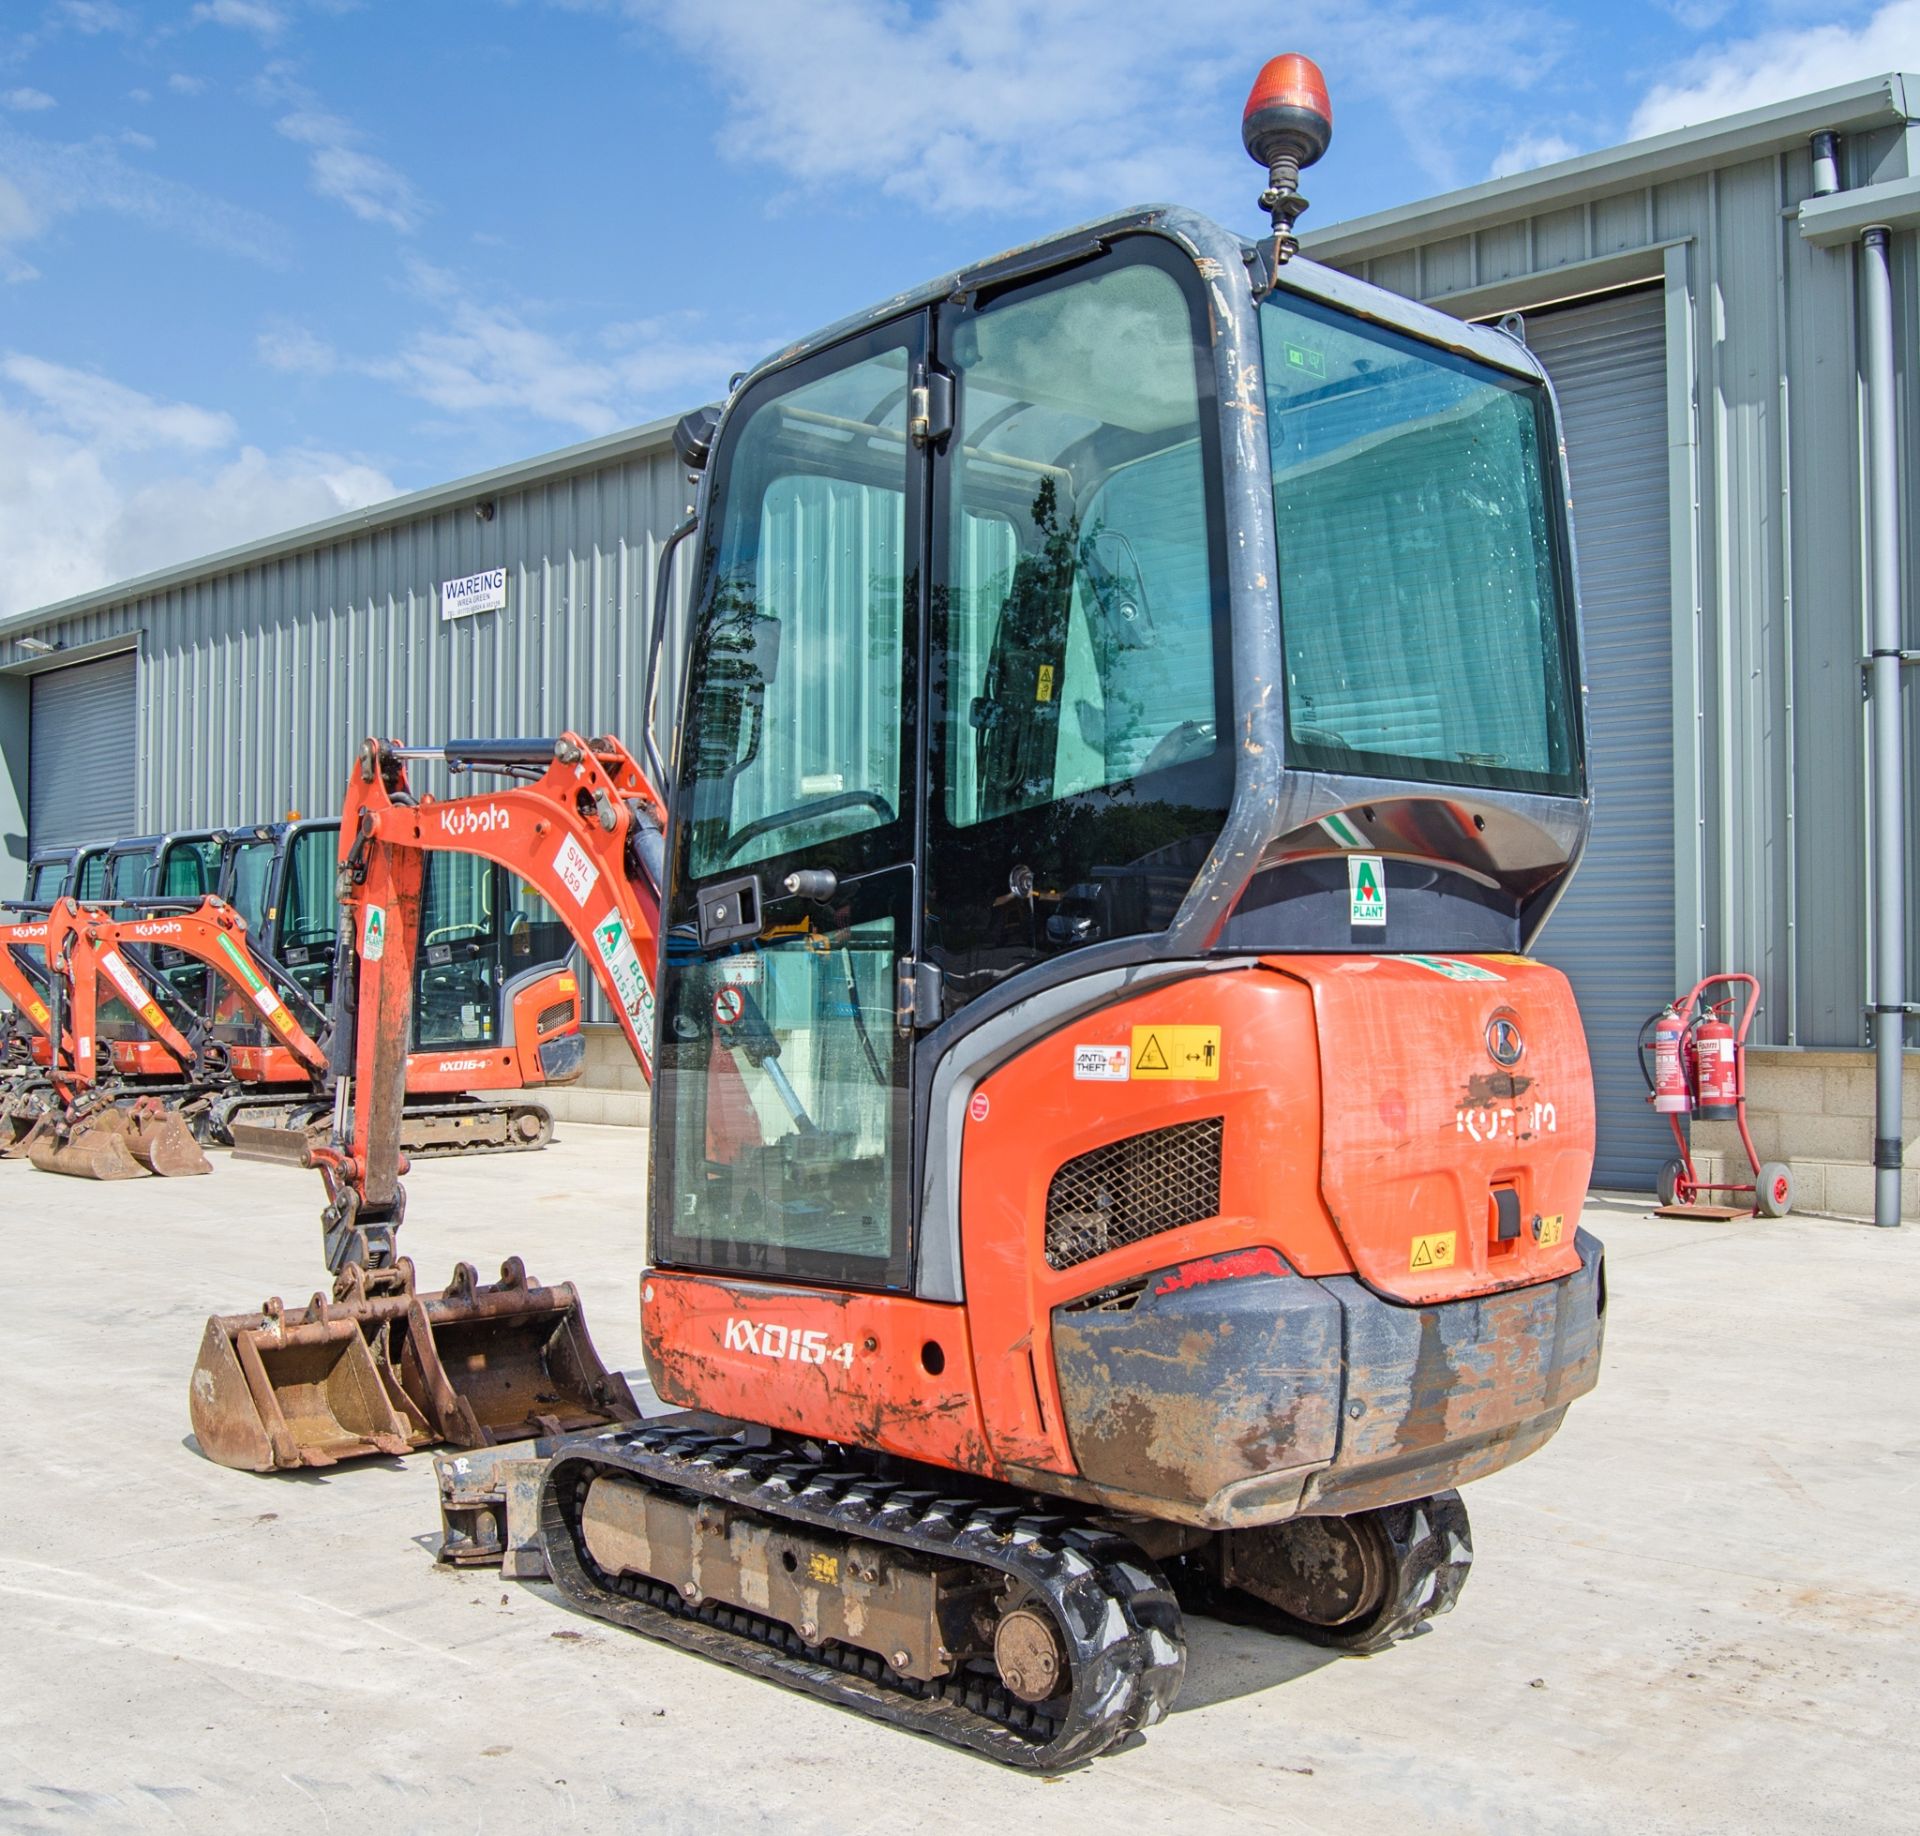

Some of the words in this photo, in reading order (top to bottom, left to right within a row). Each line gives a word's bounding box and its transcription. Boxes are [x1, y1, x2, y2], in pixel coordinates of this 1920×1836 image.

[446, 571, 503, 600] WAREING
[473, 593, 491, 605] GREEN
[441, 803, 510, 836] Kubota
[567, 846, 588, 882] SWL
[1356, 862, 1382, 902] A
[367, 911, 382, 937] A
[1353, 905, 1385, 918] PLANT
[12, 925, 48, 938] Kubot
[135, 921, 182, 937] Kubota
[602, 921, 622, 954] A
[595, 928, 612, 961] PLANT
[612, 964, 630, 1000] 0151
[1077, 1063, 1106, 1072] THEFT
